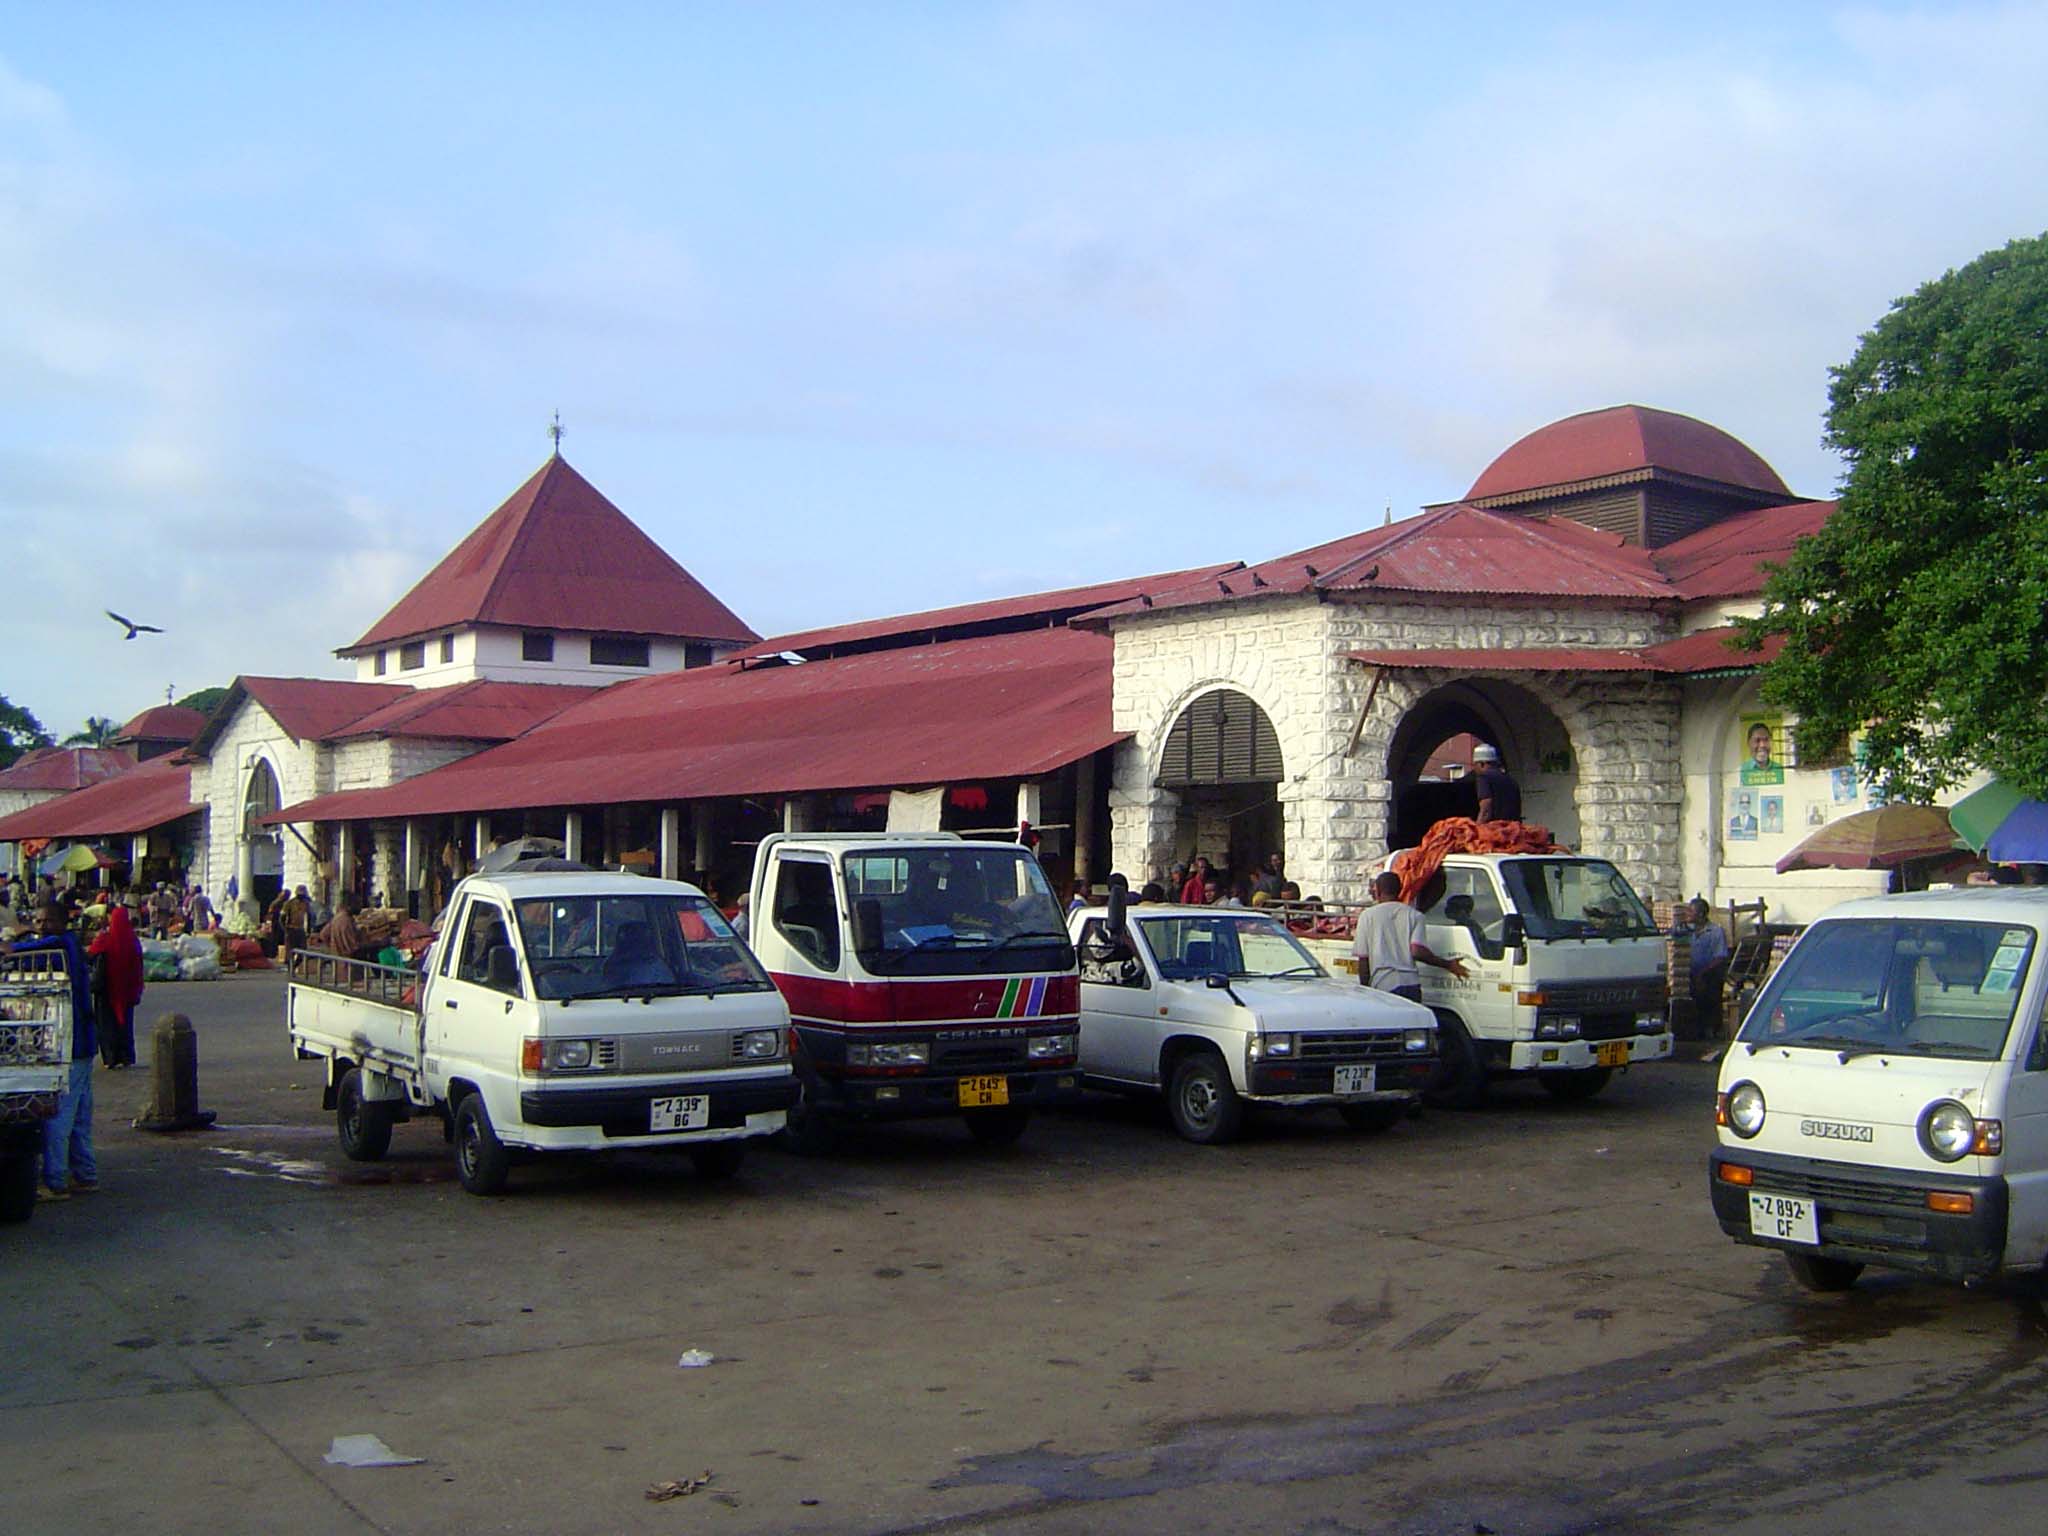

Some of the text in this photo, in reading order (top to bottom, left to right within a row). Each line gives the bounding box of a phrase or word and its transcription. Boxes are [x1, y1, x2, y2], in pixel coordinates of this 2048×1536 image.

[971, 1078, 977, 1091] Z
[665, 1097, 699, 1113] Z 339
[674, 1113, 689, 1127] BG
[1801, 1119, 1873, 1143] SUZUKI
[1764, 1197, 1803, 1220] Z 892
[1776, 1218, 1793, 1237] CF
